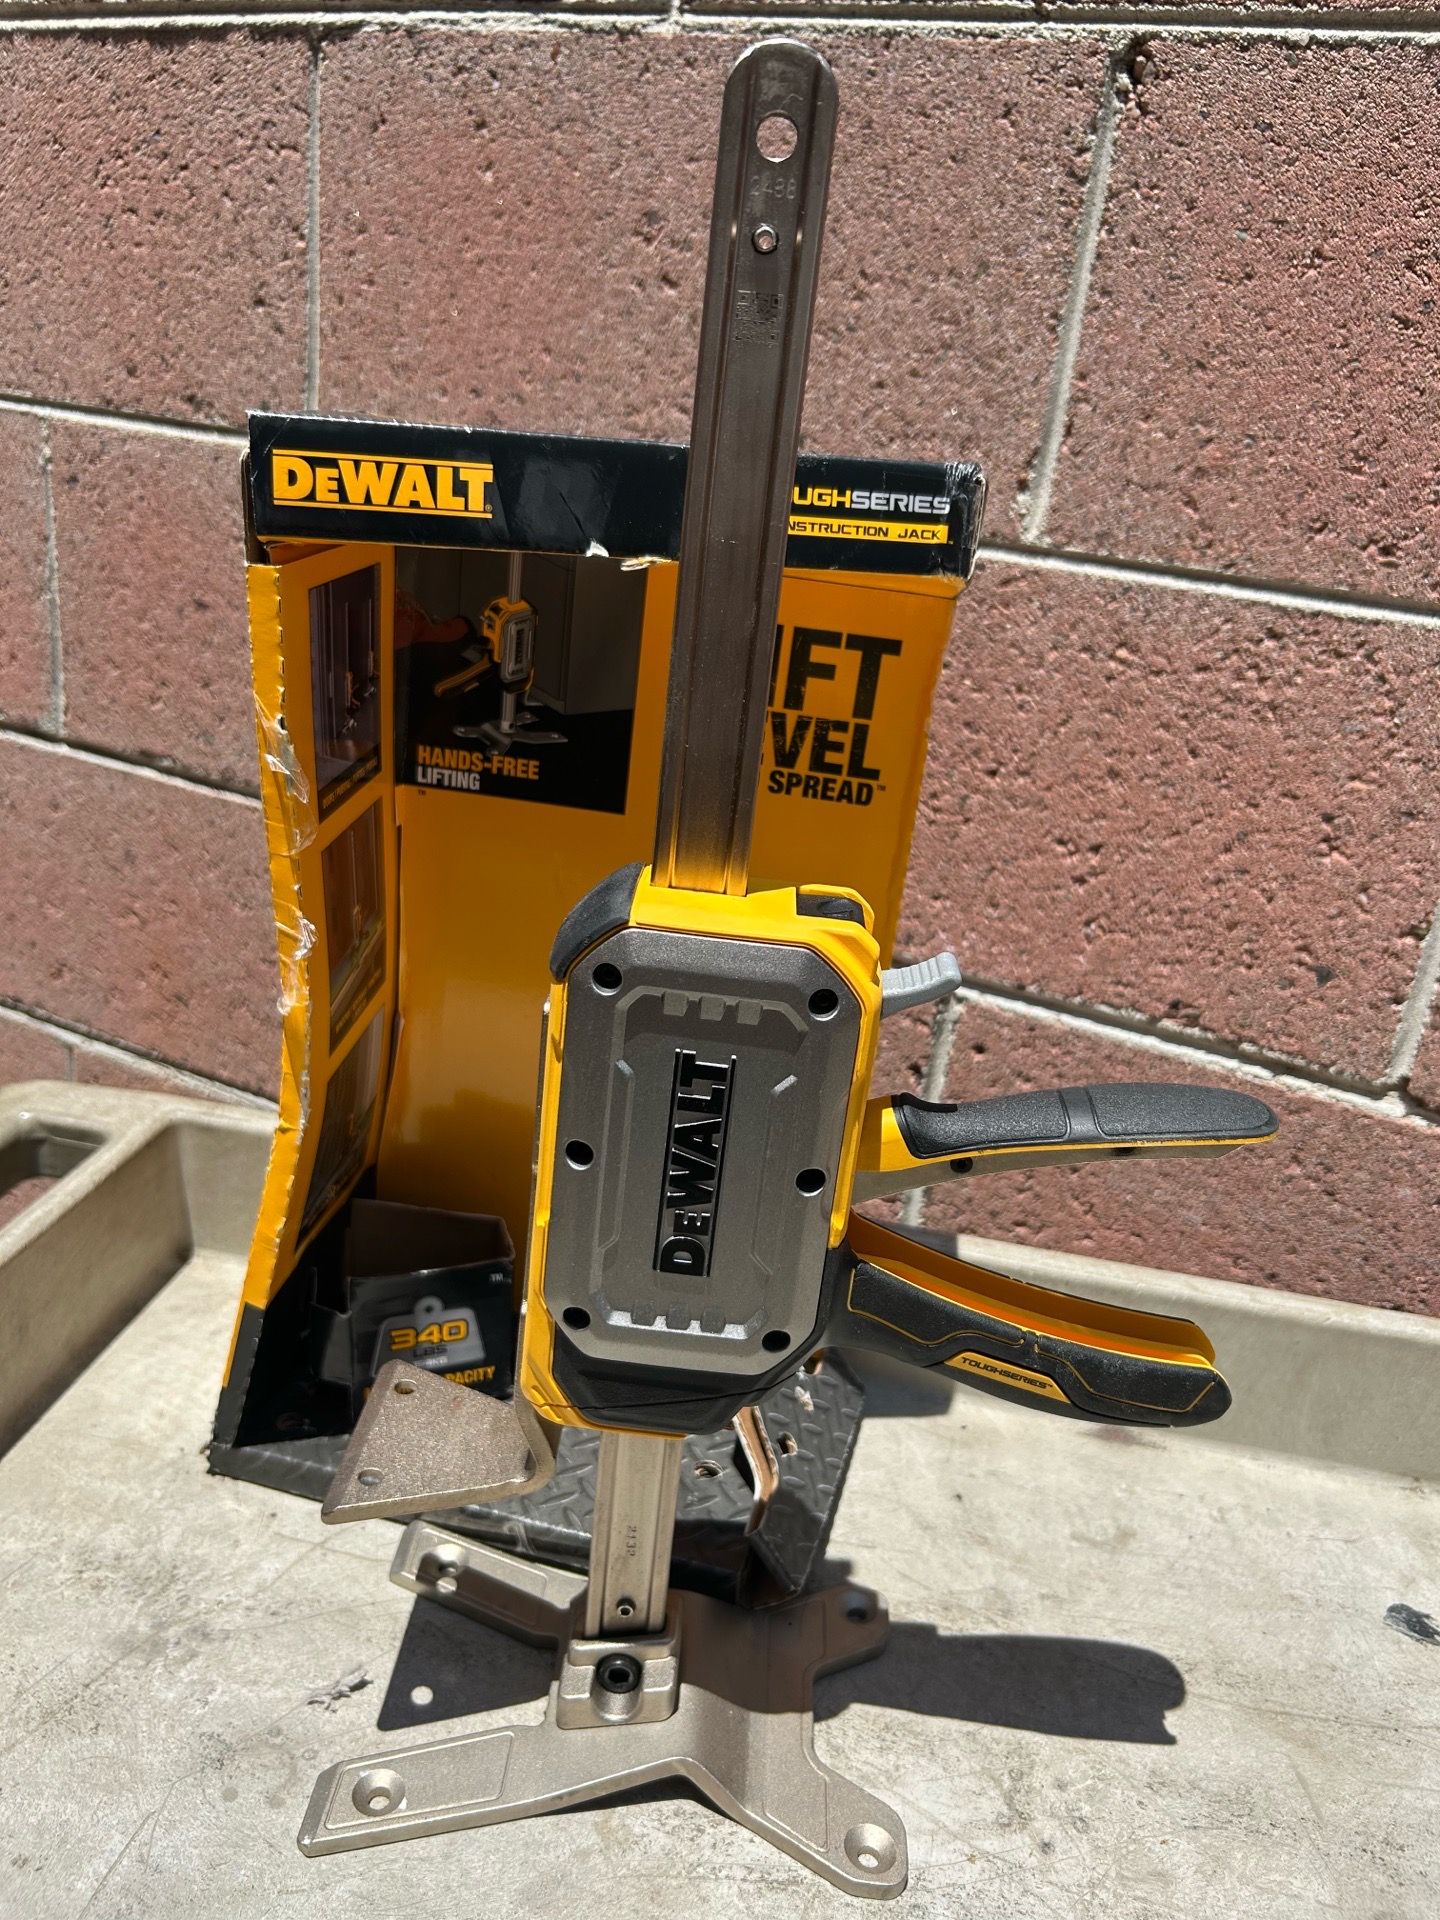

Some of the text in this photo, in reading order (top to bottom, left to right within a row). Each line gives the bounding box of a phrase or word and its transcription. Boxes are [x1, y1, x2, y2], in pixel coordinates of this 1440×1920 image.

[793, 486, 950, 514] UGHSERIES
[789, 521, 941, 541] NSTRUCTION JACK
[768, 624, 903, 721] FT
[770, 711, 881, 781] VEL
[417, 744, 540, 780] HANDS-FREE
[416, 765, 481, 791] LIFTING
[660, 1051, 729, 1276] DEWALT
[390, 1319, 469, 1350] 340
[446, 1366, 496, 1384] PACITY
[961, 1357, 1047, 1389] TOUGHSERIES
